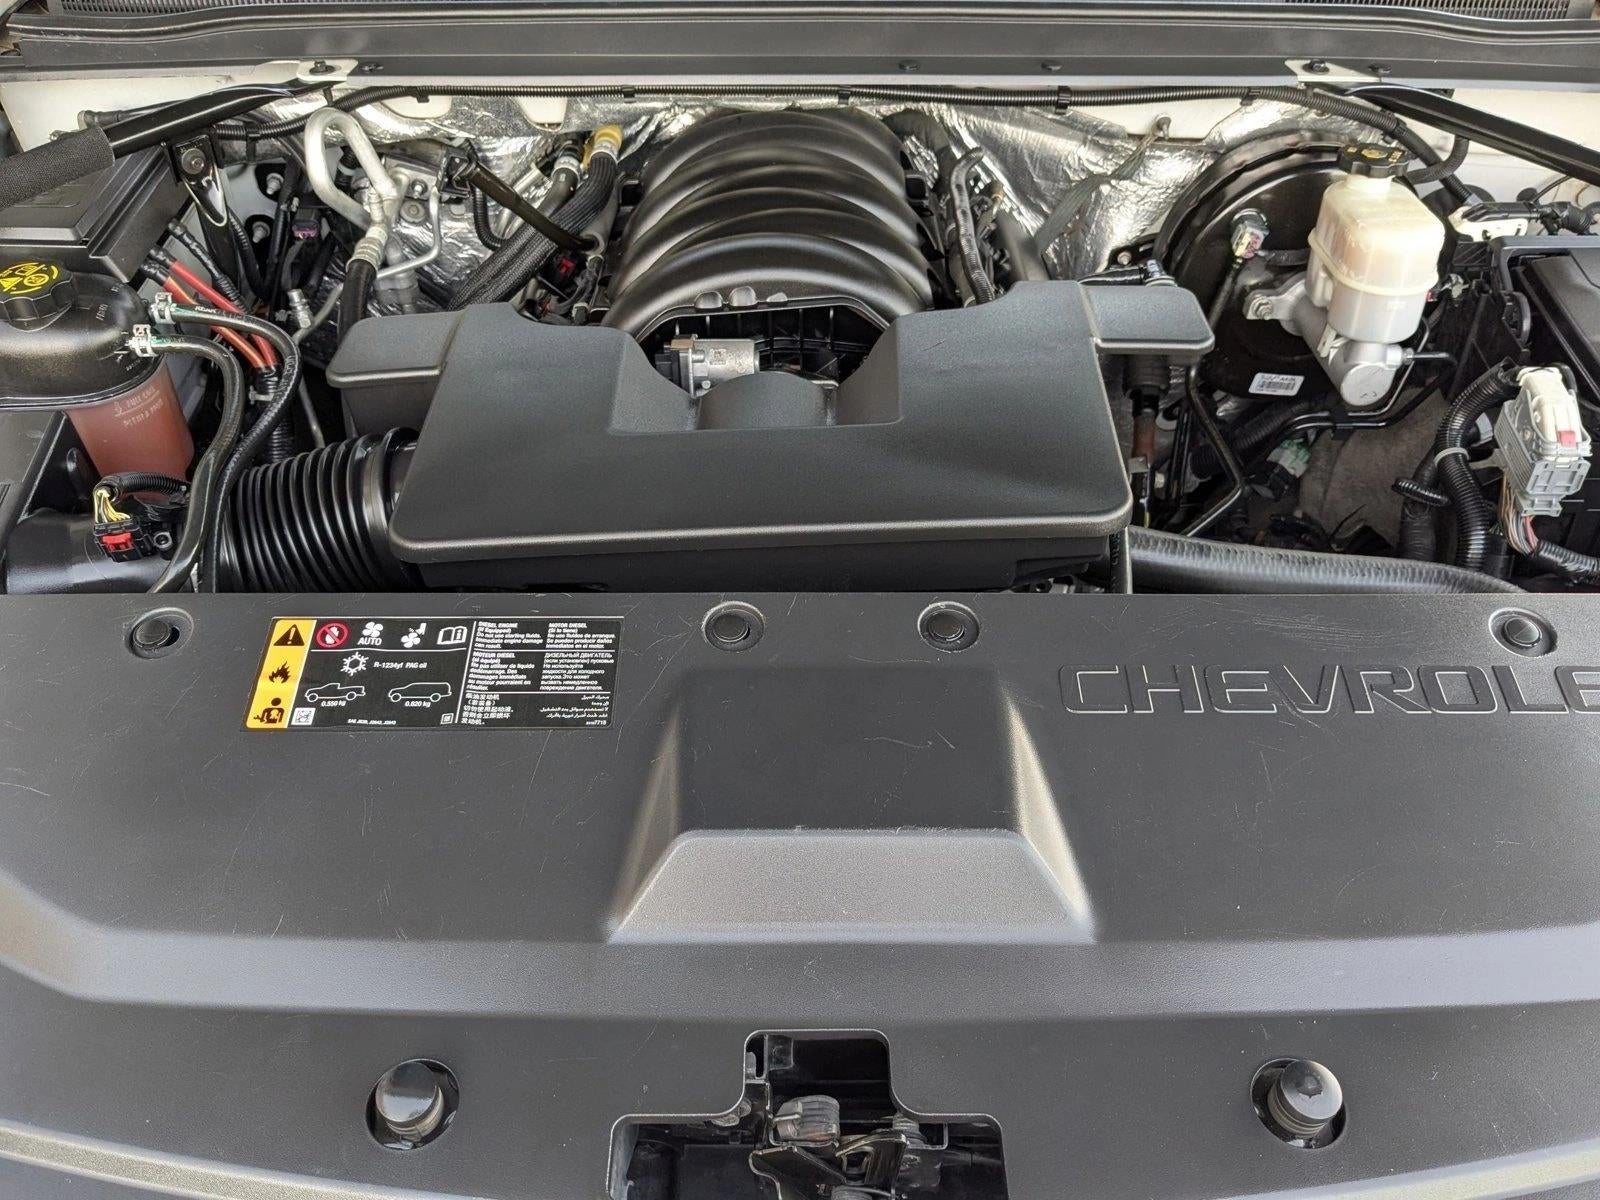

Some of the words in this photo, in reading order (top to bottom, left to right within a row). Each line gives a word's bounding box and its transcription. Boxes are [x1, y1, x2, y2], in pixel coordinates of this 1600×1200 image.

[357, 636, 383, 646] AUTO
[472, 650, 496, 658] MOTEUR
[373, 661, 403, 670] R-1234yf
[405, 661, 418, 669] PAG
[1059, 664, 1600, 715] CHEVROLE
